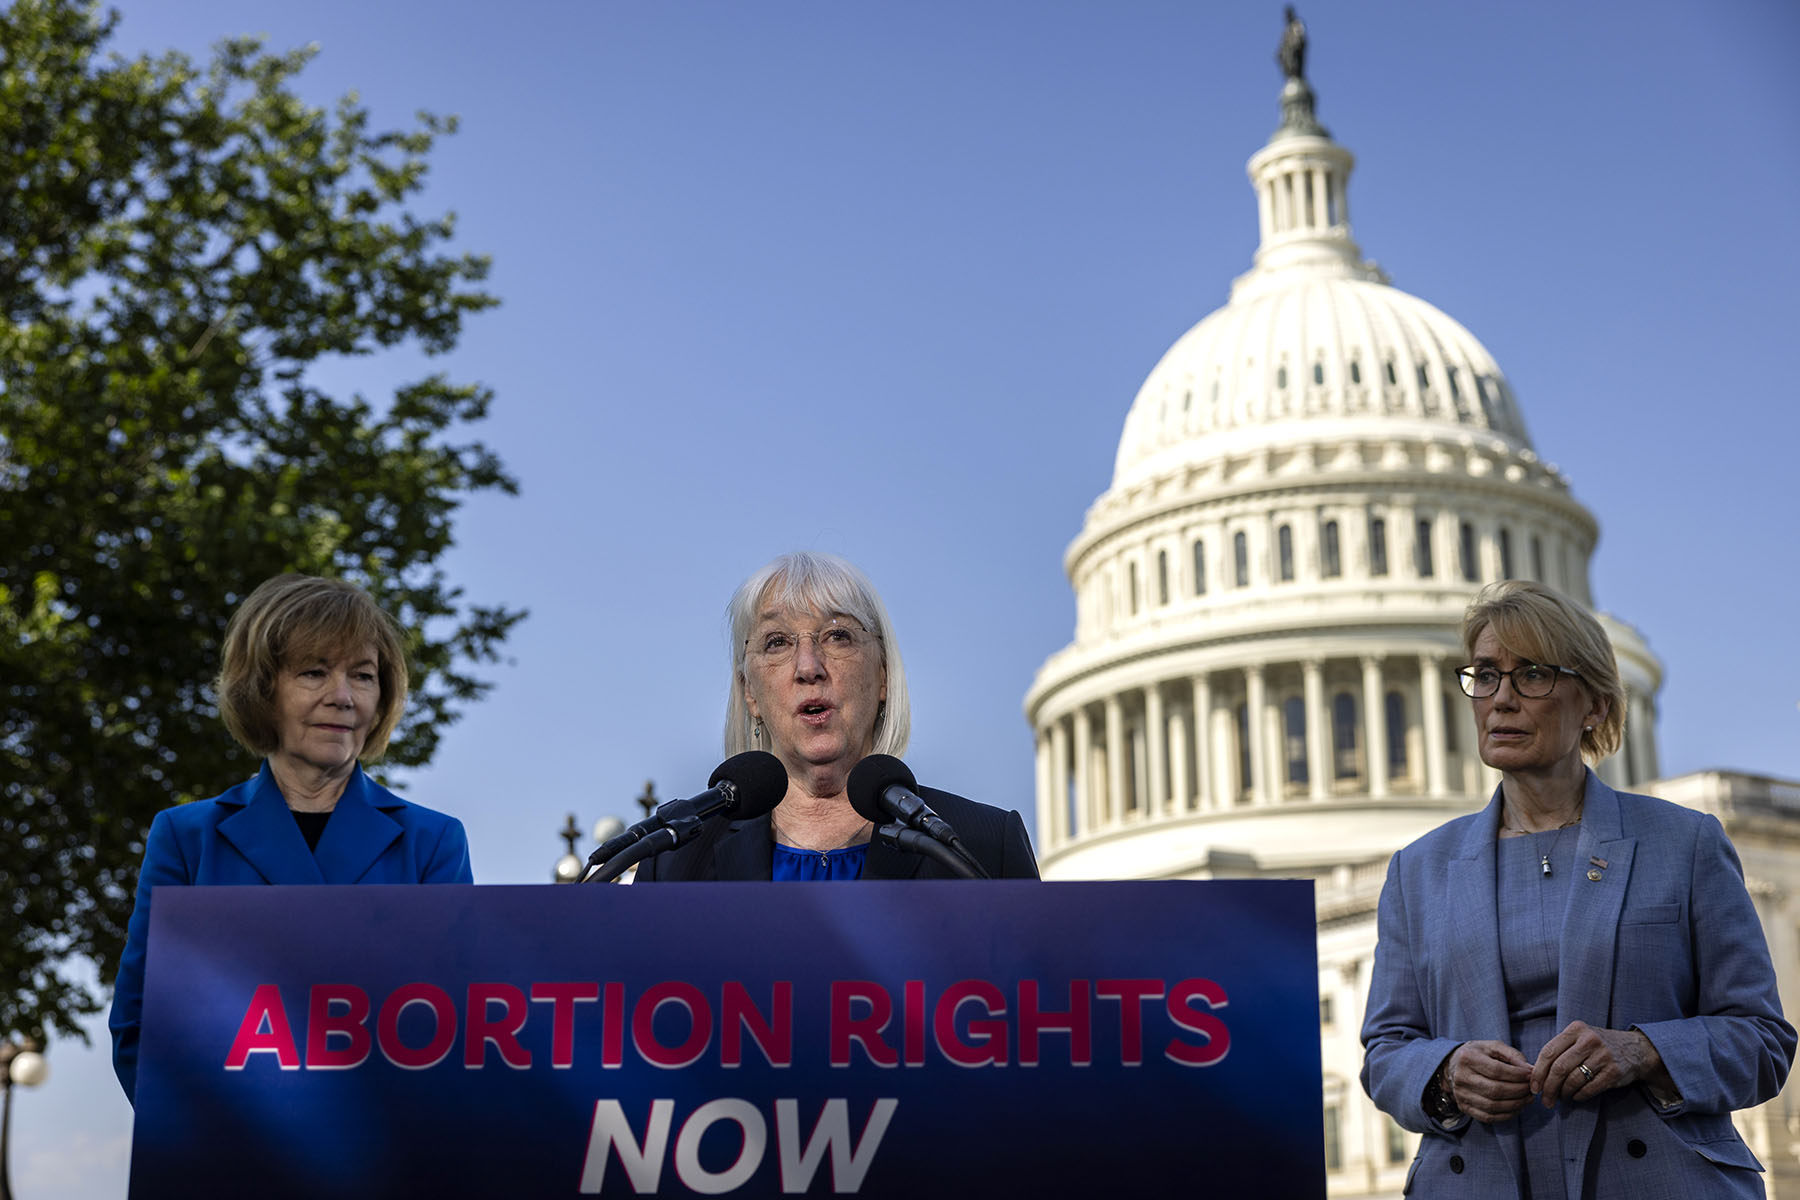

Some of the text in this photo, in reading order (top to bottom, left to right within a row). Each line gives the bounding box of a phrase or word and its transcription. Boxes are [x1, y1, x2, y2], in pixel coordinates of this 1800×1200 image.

[224, 979, 1231, 1071] ABORTION RIGHTS
[579, 1097, 899, 1195] NOW
